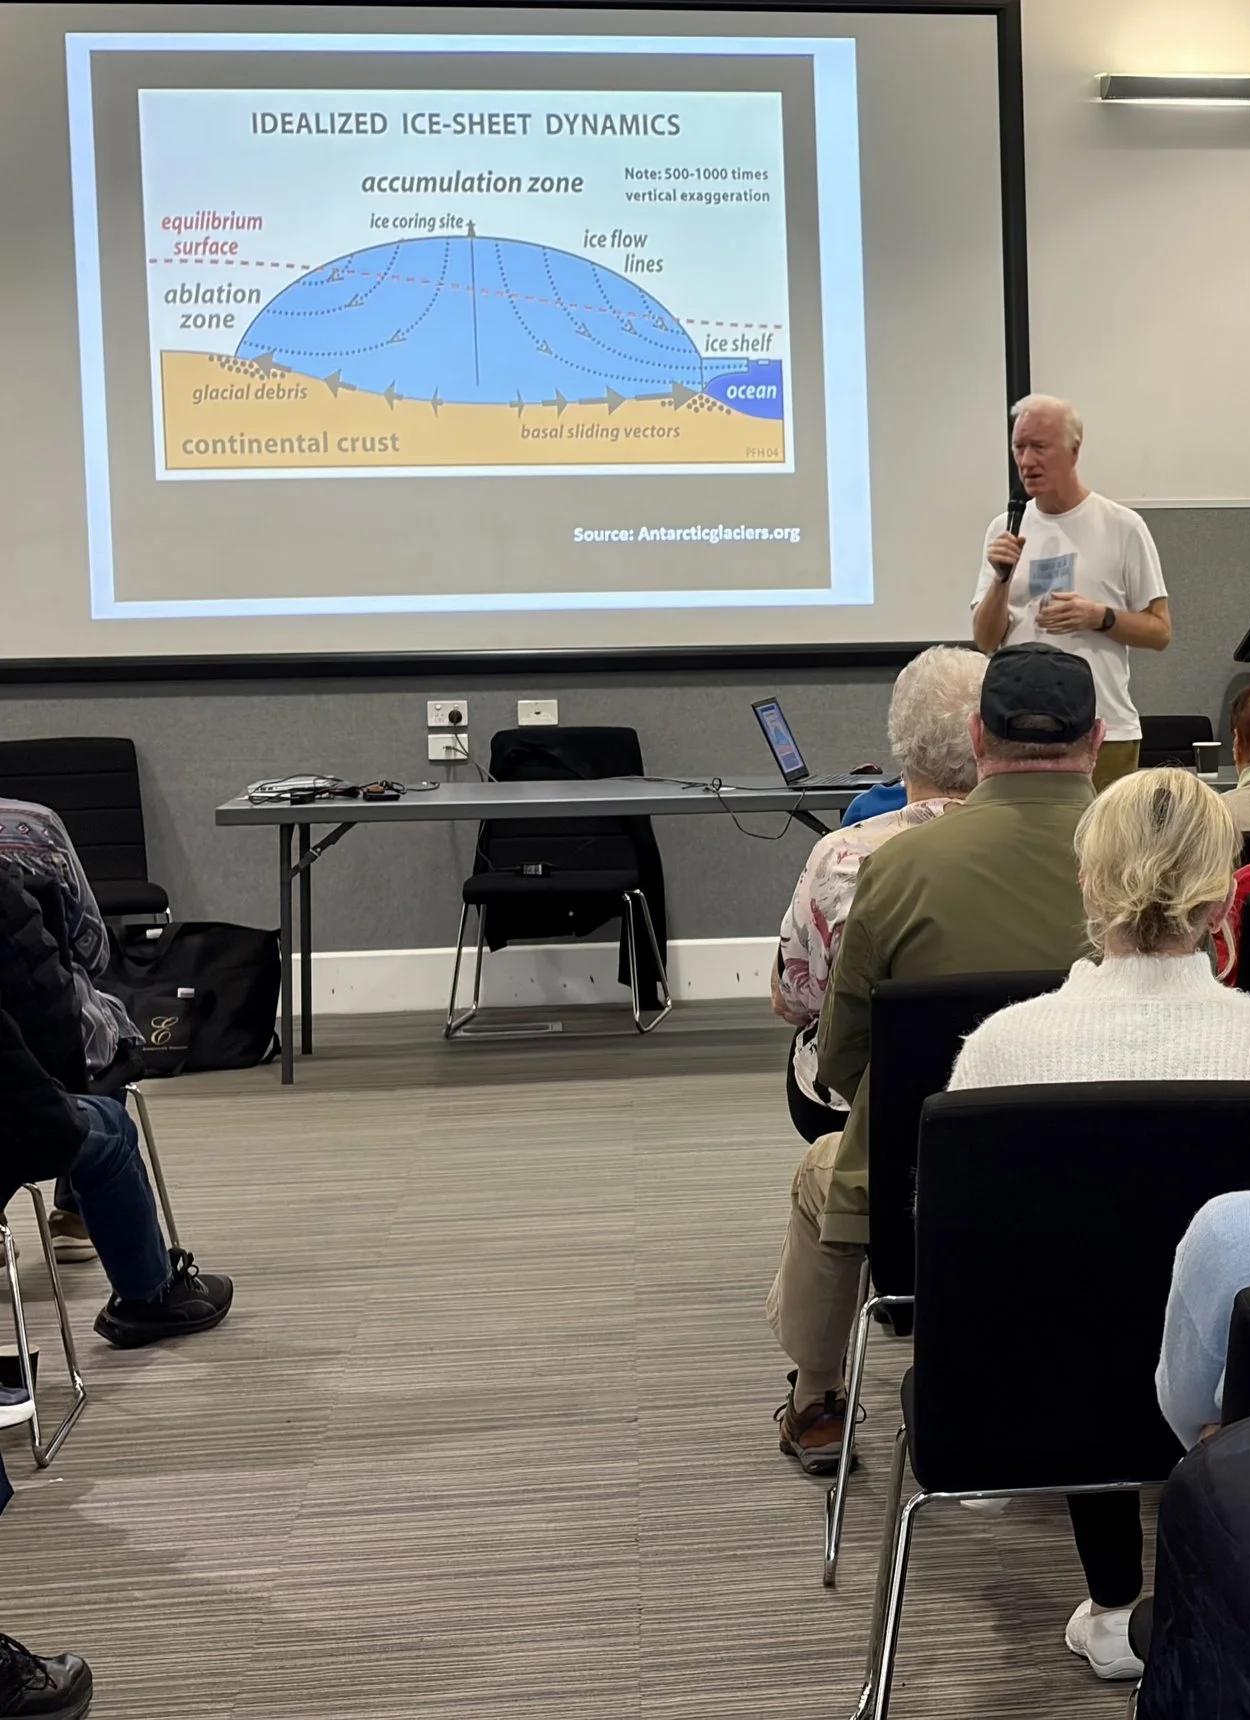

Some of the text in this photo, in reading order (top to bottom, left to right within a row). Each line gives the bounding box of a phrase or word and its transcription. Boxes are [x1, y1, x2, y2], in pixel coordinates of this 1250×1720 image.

[251, 111, 681, 136] IDEALIZED ICE-SHEET DYNAMICS
[361, 169, 584, 193] accumulation zone
[624, 167, 769, 181] Note: 500-1000 times
[625, 188, 770, 204] vertical exaggeration
[161, 210, 263, 234] equilibrium
[370, 212, 464, 233] ice coring site
[173, 235, 239, 255] surface
[583, 229, 648, 249] ice flow
[624, 253, 664, 273] lines
[164, 282, 261, 304] ablation
[180, 311, 235, 329] zone
[705, 332, 774, 353] ice shelf
[192, 383, 308, 405] glacial debris
[726, 384, 777, 399] ocean
[520, 422, 681, 442] basal sliding vectors
[181, 431, 400, 455] continental crust
[573, 525, 801, 544] Source: Antarcticglaciers.org
